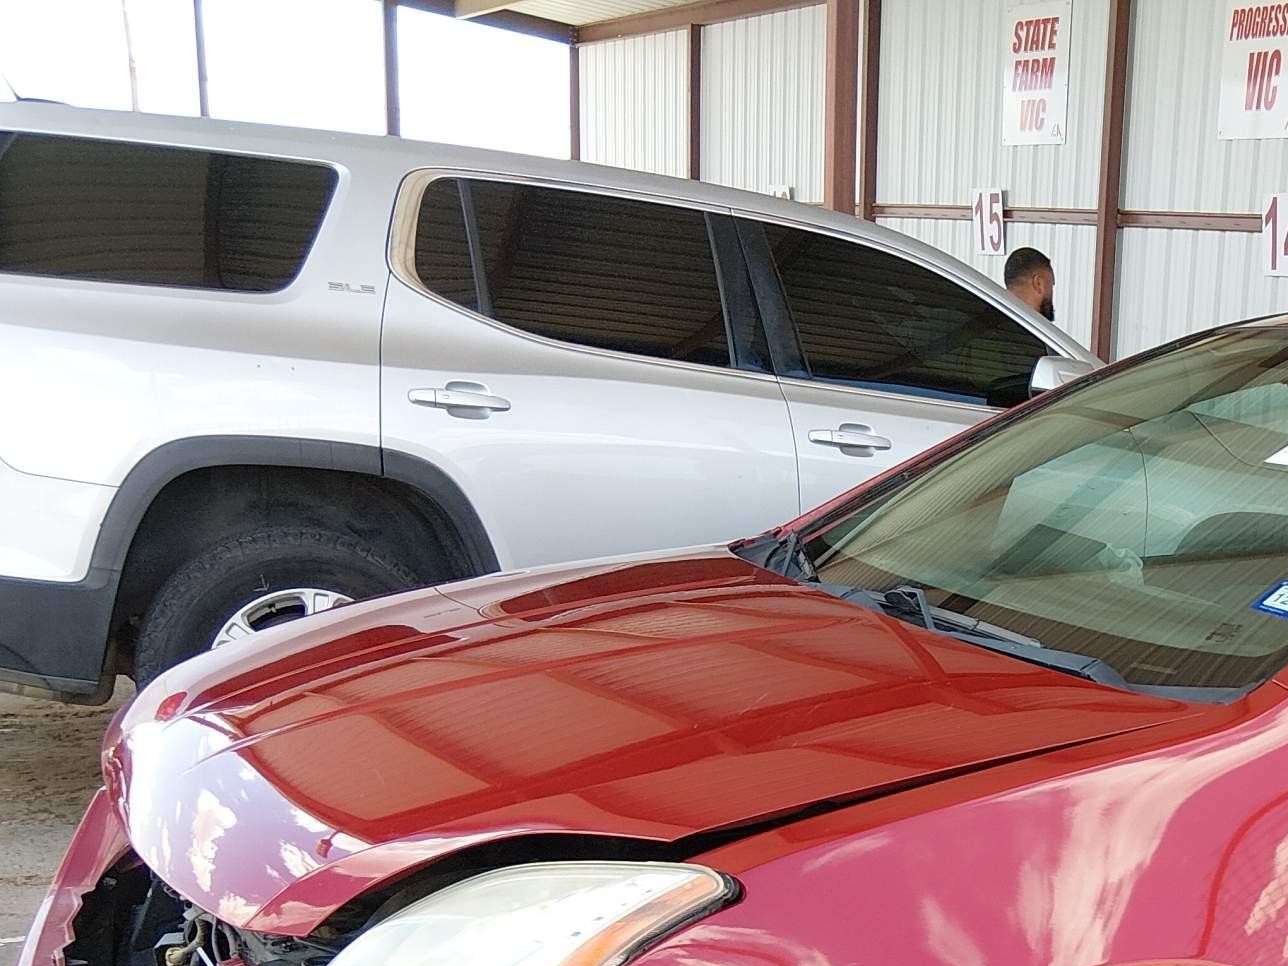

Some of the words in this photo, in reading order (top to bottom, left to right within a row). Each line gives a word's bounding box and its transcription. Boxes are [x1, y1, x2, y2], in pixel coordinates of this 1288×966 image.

[1012, 16, 1060, 54] STATE
[1011, 57, 1057, 91] FARM
[1244, 48, 1282, 111] VIC
[1019, 98, 1047, 131] VIC
[974, 191, 1003, 252] 15
